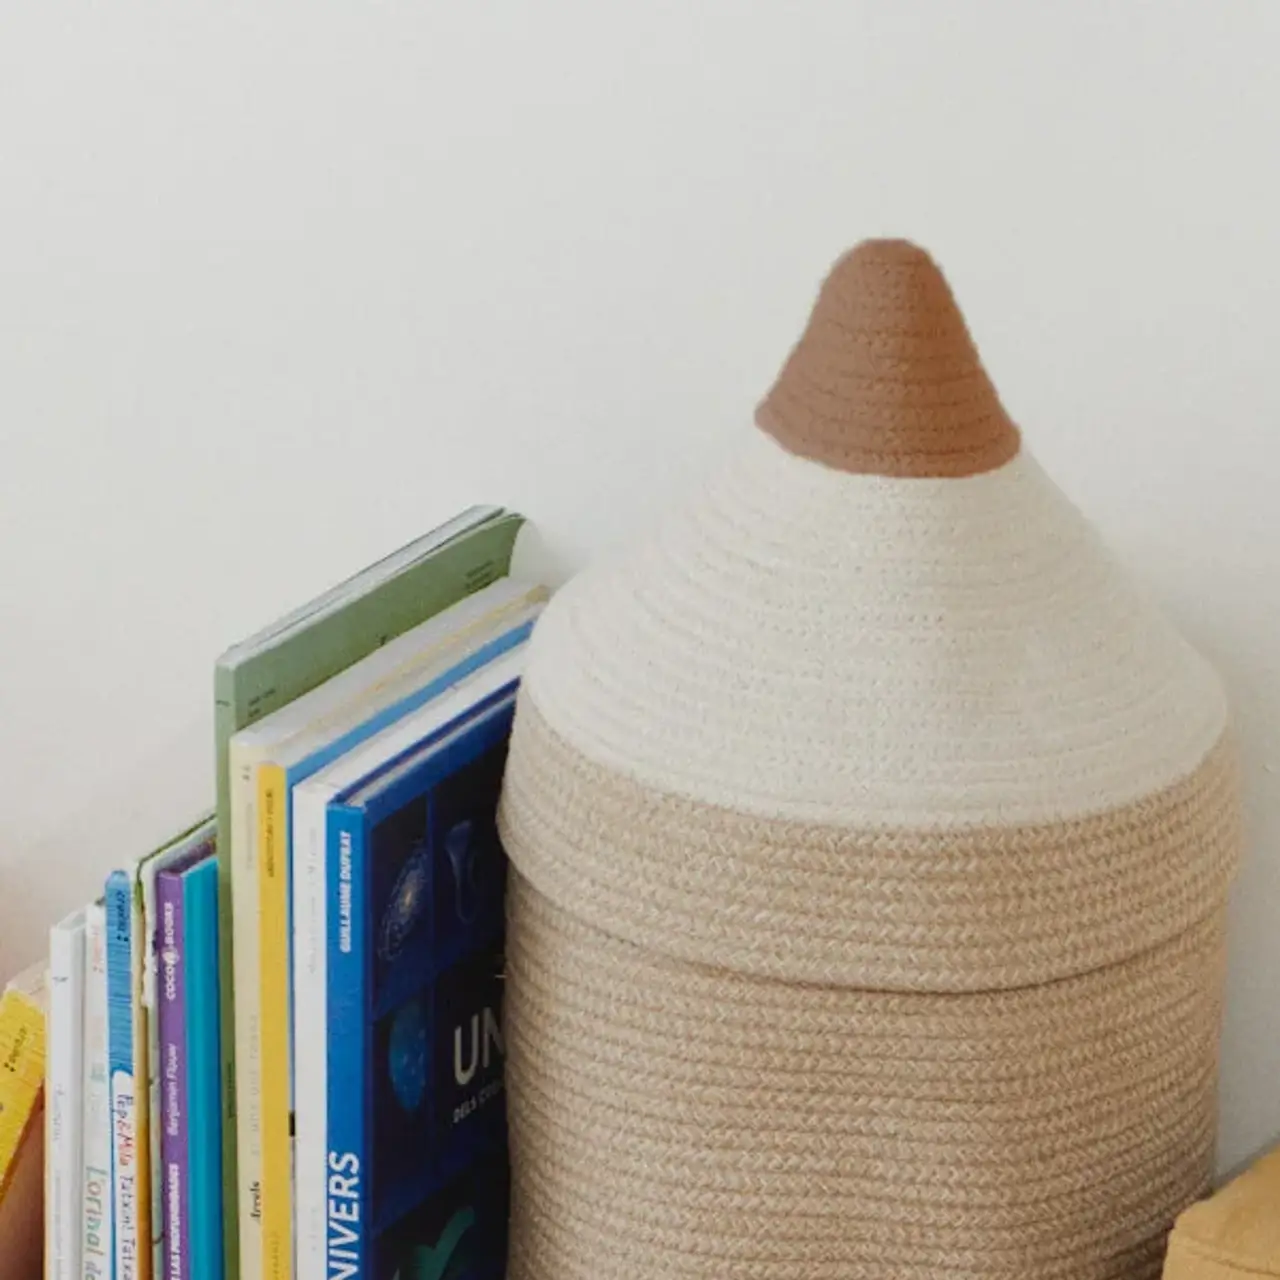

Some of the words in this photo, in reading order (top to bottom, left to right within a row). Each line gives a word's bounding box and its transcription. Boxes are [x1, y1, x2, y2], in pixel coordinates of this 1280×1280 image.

[164, 901, 175, 945] BOOKS
[339, 880, 351, 954] GUILLAUME
[167, 1080, 181, 1137] Benjamin
